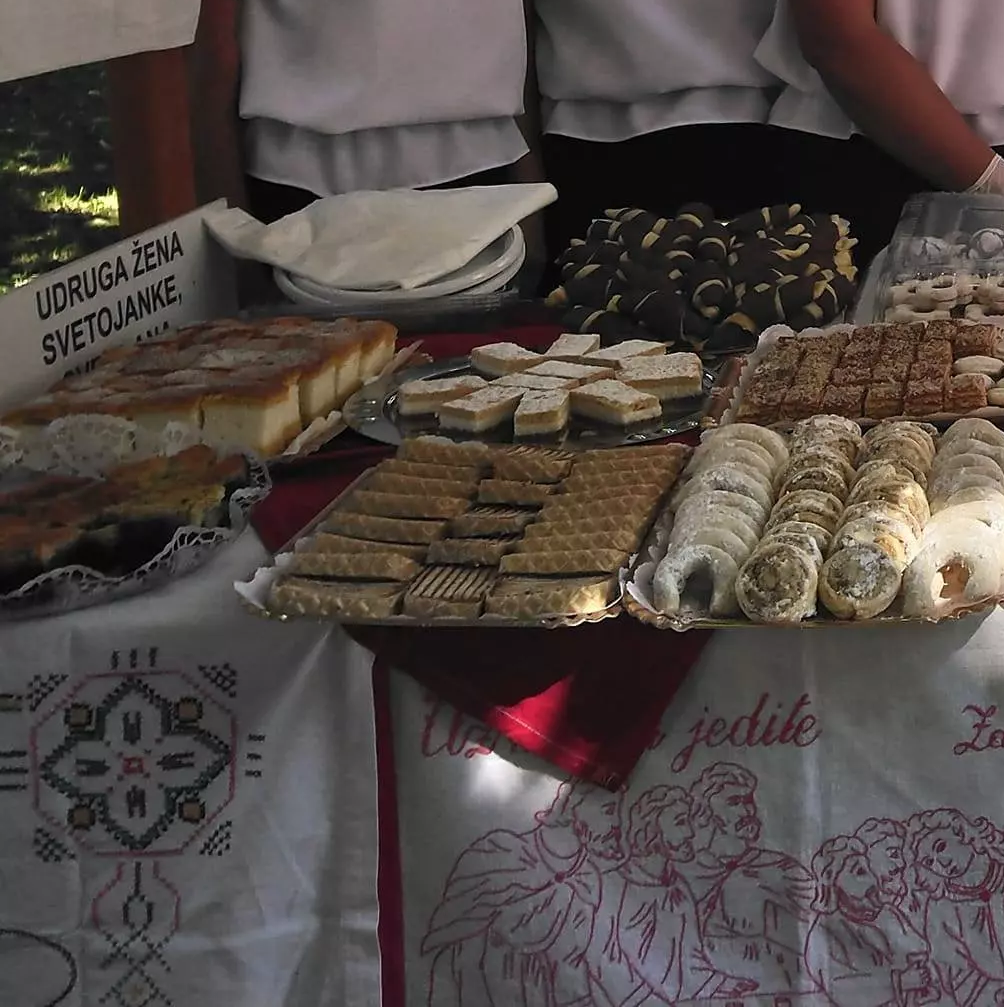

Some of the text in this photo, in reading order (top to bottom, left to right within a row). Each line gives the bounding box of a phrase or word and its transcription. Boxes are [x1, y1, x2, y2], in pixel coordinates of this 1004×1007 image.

[36, 231, 184, 321] UDRUGA ŽENA
[41, 274, 183, 366] SVETOJANKE,
[670, 691, 823, 774] jedite
